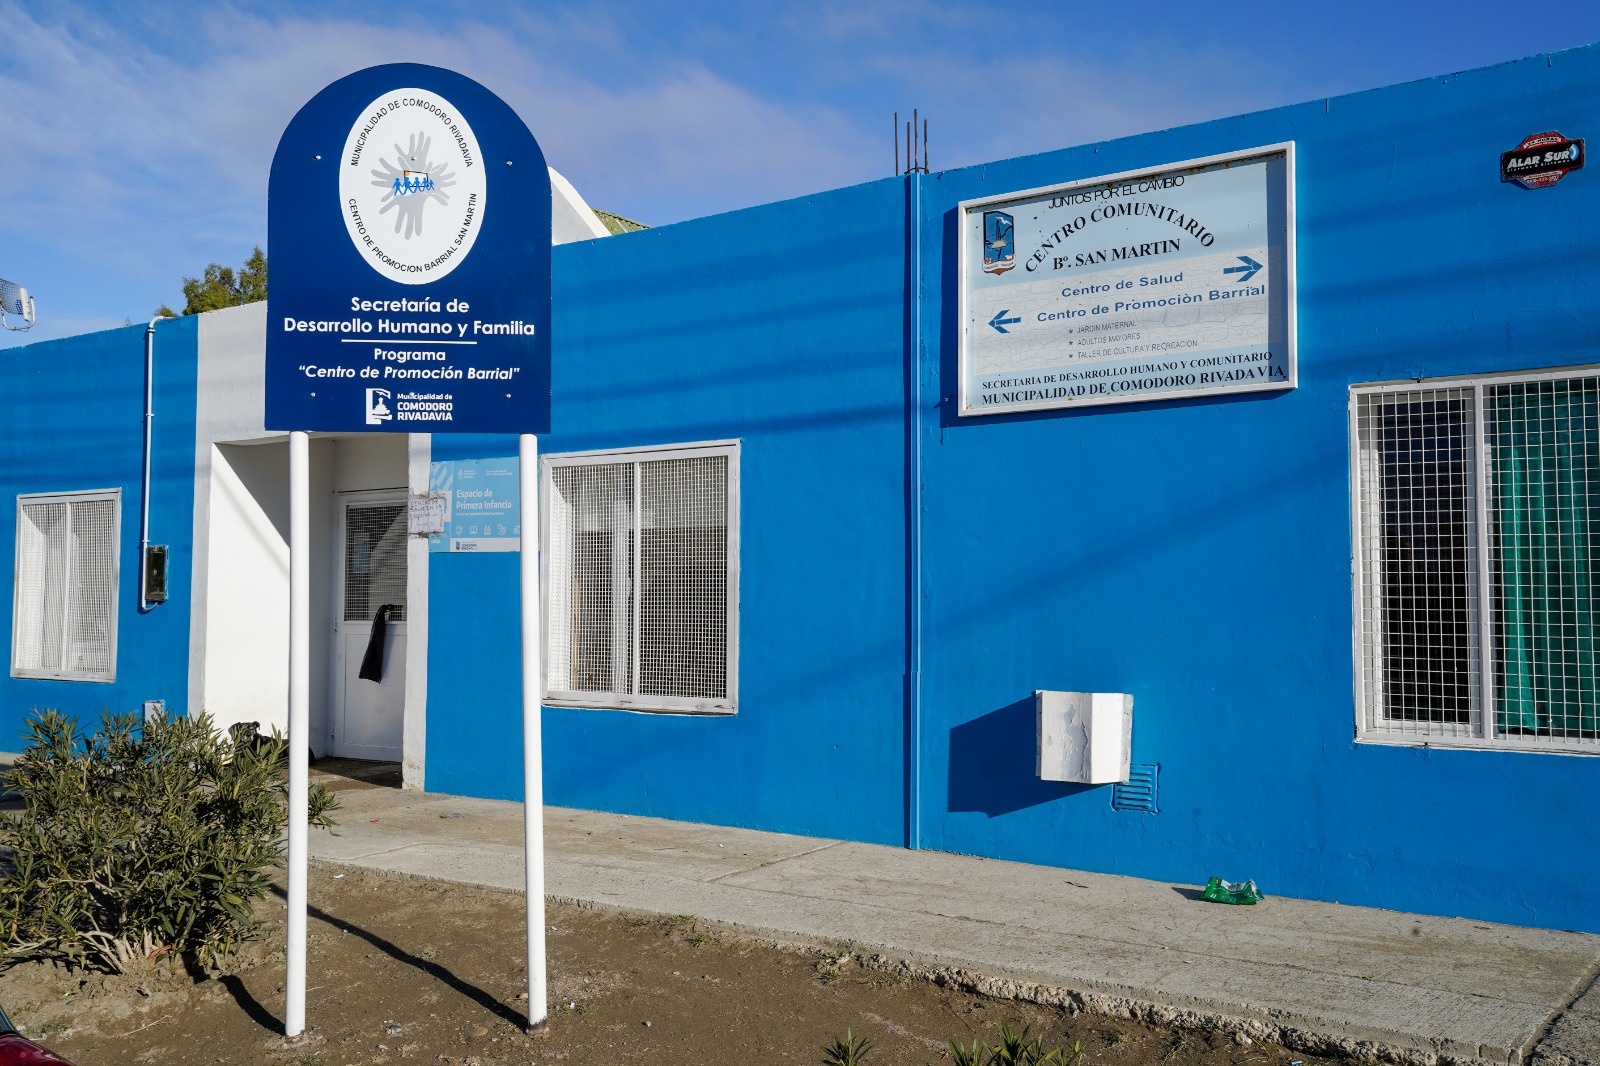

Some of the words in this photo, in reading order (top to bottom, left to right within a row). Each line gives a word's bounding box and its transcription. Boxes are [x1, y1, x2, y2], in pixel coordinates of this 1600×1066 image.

[351, 107, 388, 166] MUNICIPALIDAD
[387, 100, 400, 111] DE
[402, 98, 452, 125] COMODORO
[449, 124, 473, 168] RIVADAVIA
[1507, 156, 1540, 169] ALAR
[1544, 151, 1570, 162] SUR
[1049, 192, 1092, 210] JUNTOS
[1094, 187, 1120, 202] POR
[1122, 184, 1136, 196] EL
[1138, 175, 1185, 193] CAMBIO
[348, 198, 366, 235] CENTRO
[362, 234, 375, 247] DE
[371, 246, 423, 273] PROMOCION
[424, 246, 458, 271] BARRIAL
[454, 227, 468, 246] SAN
[463, 193, 477, 227] MARTIN
[1025, 216, 1086, 273] CENTRO
[1090, 202, 1215, 248] COMUNITARIO
[1075, 249, 1107, 267] SAN
[1111, 238, 1181, 262] MARTIN
[1061, 283, 1111, 298] Centro
[1115, 279, 1134, 290] de
[1139, 272, 1183, 287] Salud
[351, 296, 441, 313] Secretaría
[446, 298, 470, 313] de
[1037, 308, 1087, 322] Centro
[1091, 305, 1110, 315] de
[1208, 284, 1265, 301] Barrial
[284, 317, 373, 333] Desarrollo
[378, 318, 453, 334] Humano
[457, 323, 469, 338] y
[473, 320, 535, 336] Familia
[1101, 320, 1137, 332] MATERNAL
[1077, 336, 1107, 346] ADULTOS
[1108, 332, 1141, 343] MAYORES
[374, 347, 446, 364] Programa
[1077, 350, 1101, 359] TALLER
[1103, 348, 1112, 357] DE
[1145, 344, 1151, 352] Y
[1151, 339, 1198, 351] RECREACON
[360, 366, 380, 378] de
[384, 365, 463, 379] Promoción
[982, 375, 1041, 390] SECRETARIA
[1043, 373, 1057, 384] DE
[1059, 366, 1128, 382] DESARROLLO
[1130, 361, 1178, 375] HUMANO
[1180, 360, 1188, 369] Y
[1190, 351, 1273, 368] COMUNITARIO
[397, 391, 443, 401] Municipalidad
[982, 385, 1086, 405] MUNICIPALIDAD
[1089, 382, 1107, 395] DE
[1110, 374, 1196, 393] COMODORO
[397, 401, 453, 411] COMODORO
[397, 411, 453, 421] RIVADAVIA
[456, 489, 483, 500] Espacio
[483, 488, 493, 498] de
[456, 501, 482, 510] Primera
[484, 500, 512, 509] Infancia
